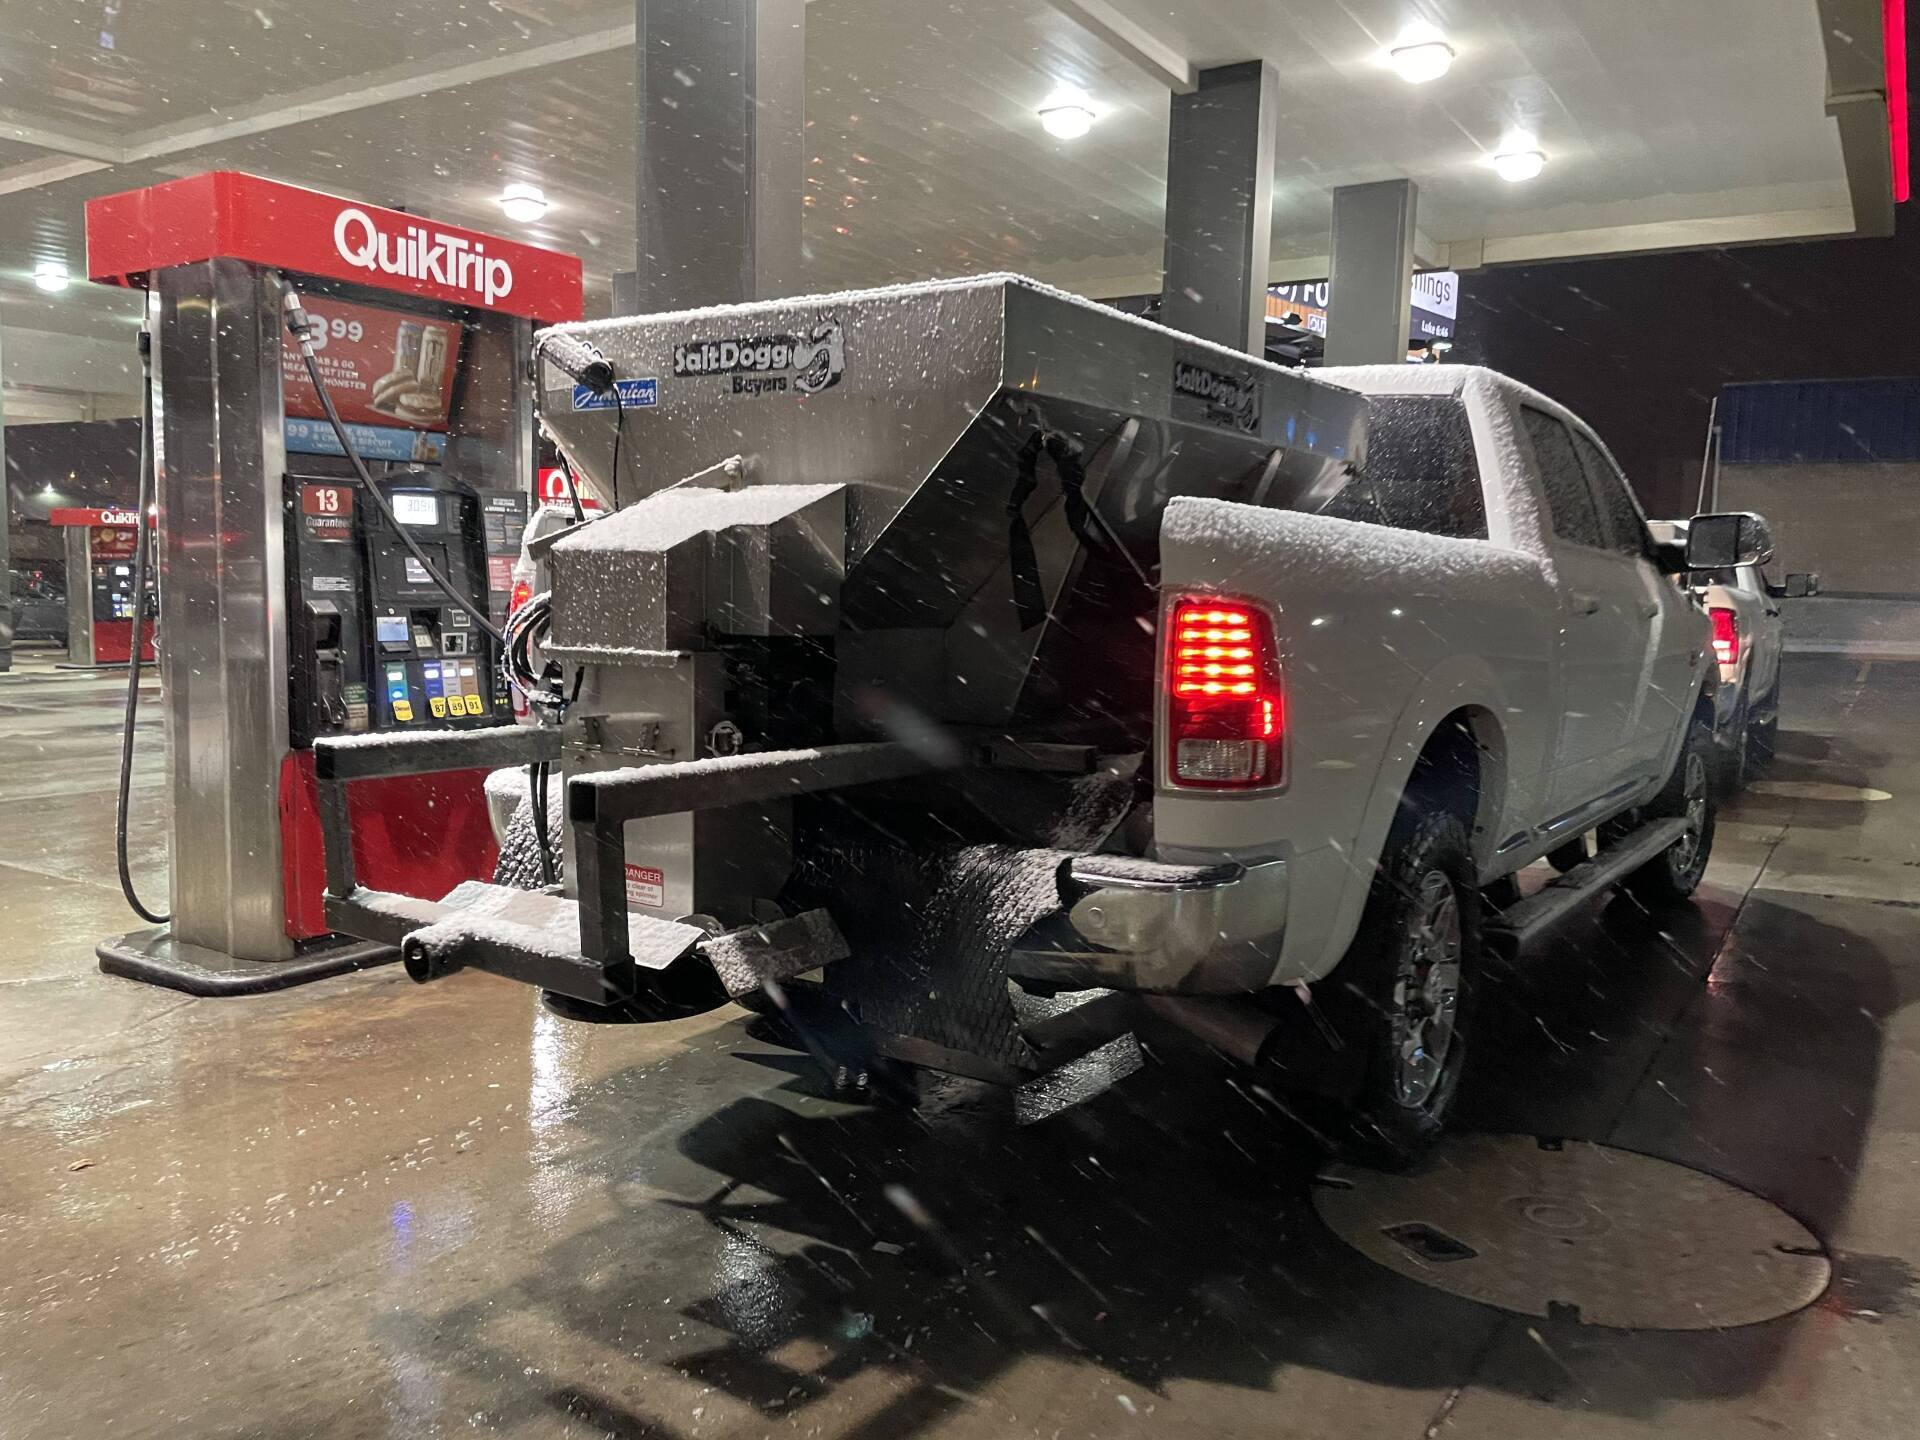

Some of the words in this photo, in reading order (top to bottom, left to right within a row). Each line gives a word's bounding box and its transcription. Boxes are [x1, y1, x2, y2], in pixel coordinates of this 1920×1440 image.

[334, 208, 512, 305] QuikTrip
[1421, 319, 1436, 335] Luke
[341, 359, 355, 369] GO
[675, 342, 790, 373] SaltDogg
[323, 377, 367, 390] MONSTER
[732, 376, 787, 396] Buyers
[315, 488, 339, 512] 13
[434, 704, 445, 713] 87
[452, 702, 463, 711] 89
[469, 701, 479, 710] 91
